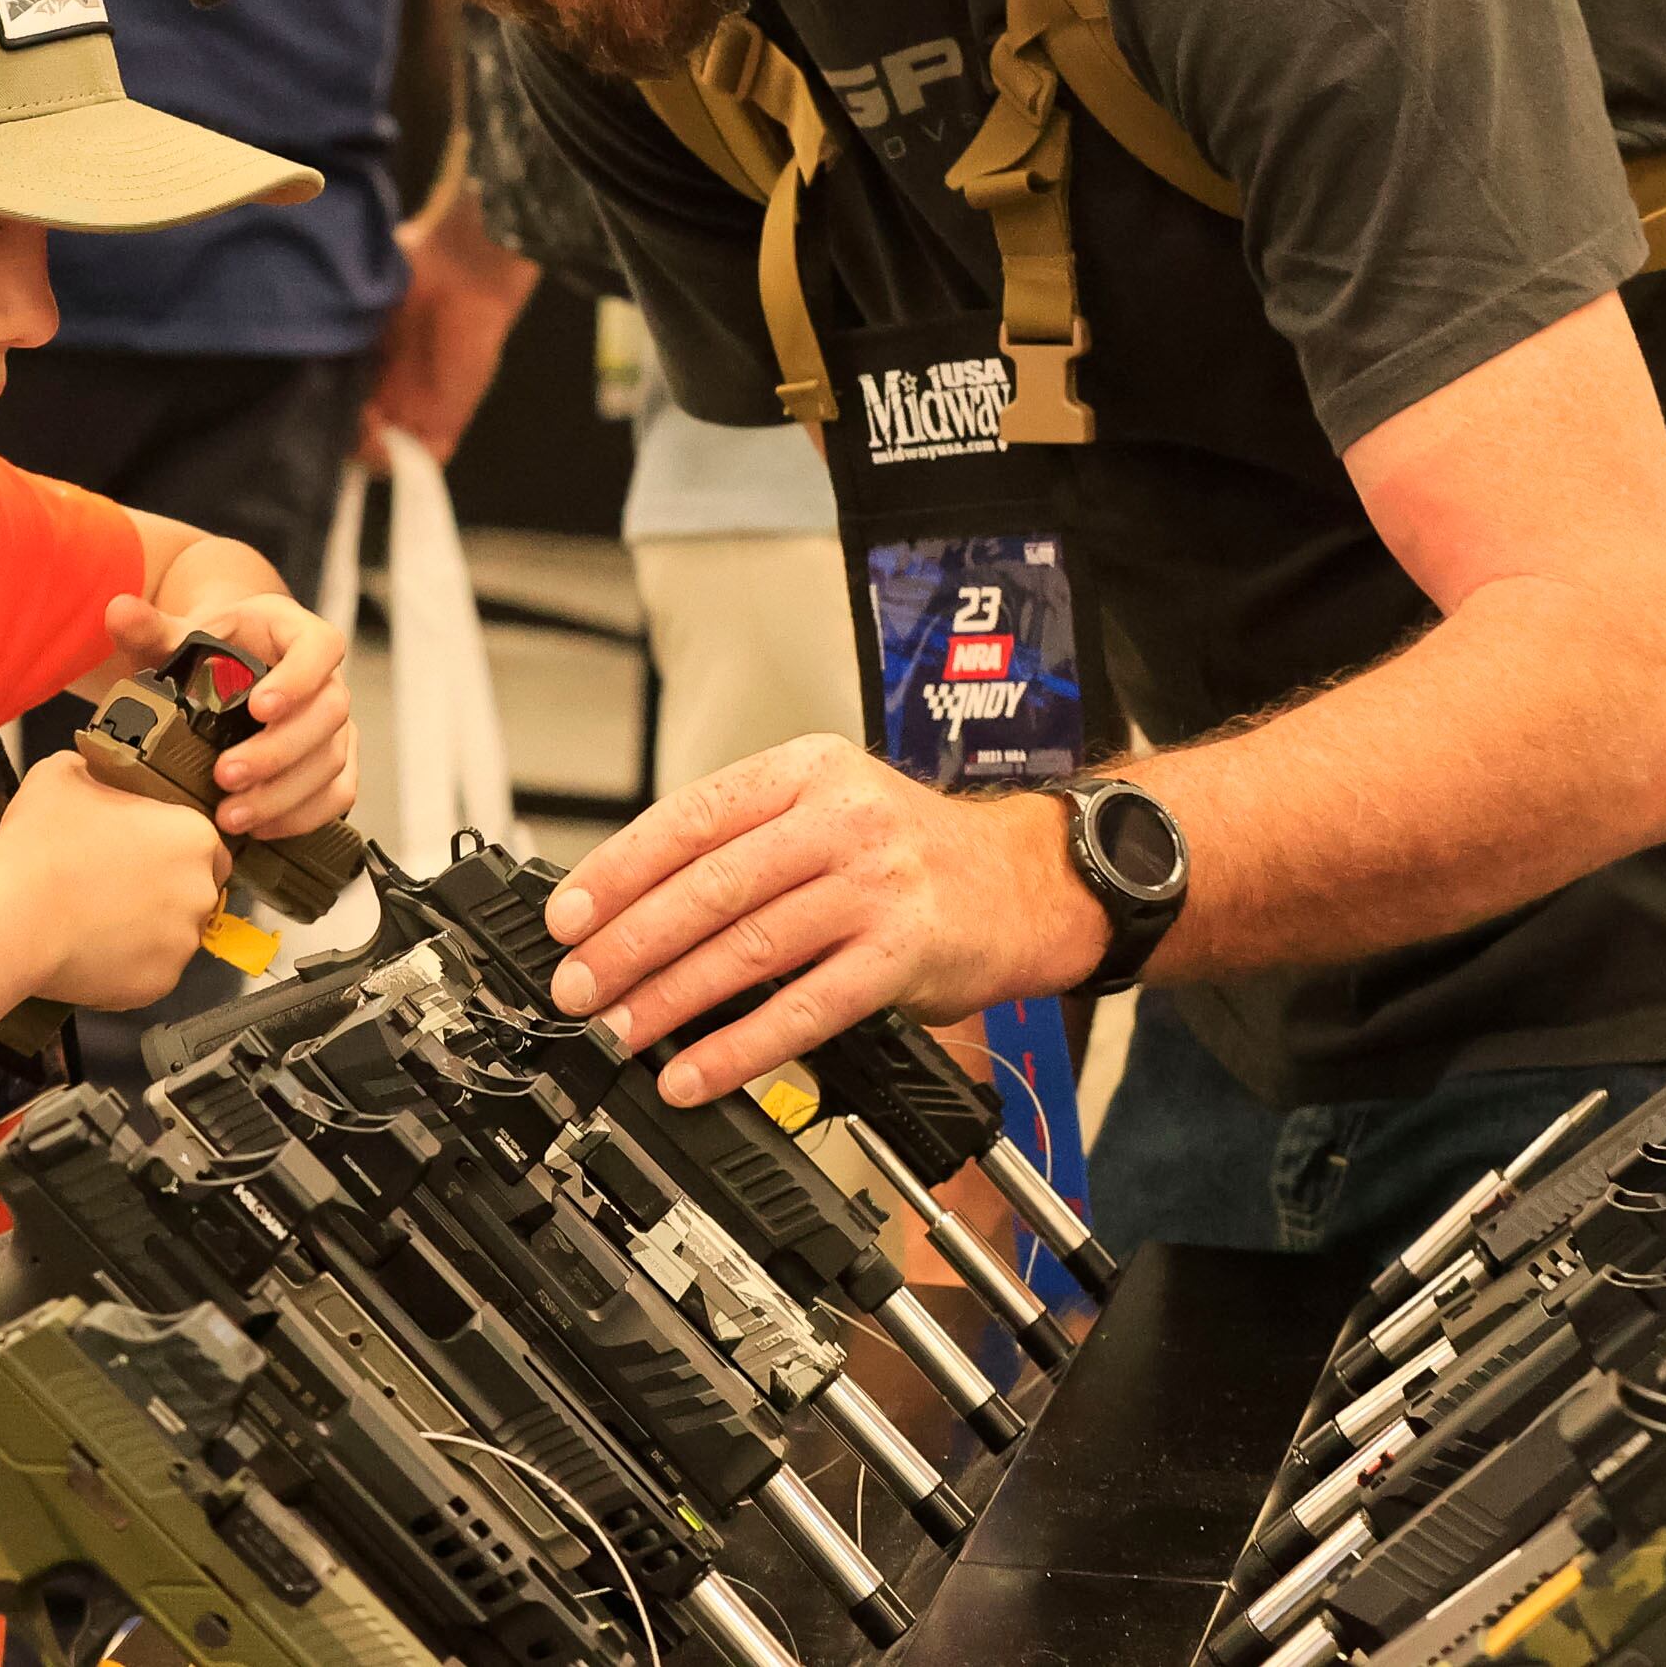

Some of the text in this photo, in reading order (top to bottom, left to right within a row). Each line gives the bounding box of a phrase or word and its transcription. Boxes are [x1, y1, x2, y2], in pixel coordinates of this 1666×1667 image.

[939, 357, 1009, 388] USA
[858, 365, 1011, 452] Midway
[871, 438, 996, 465] midwayusa.com
[952, 586, 1002, 633] 23
[952, 643, 1003, 674] NRA
